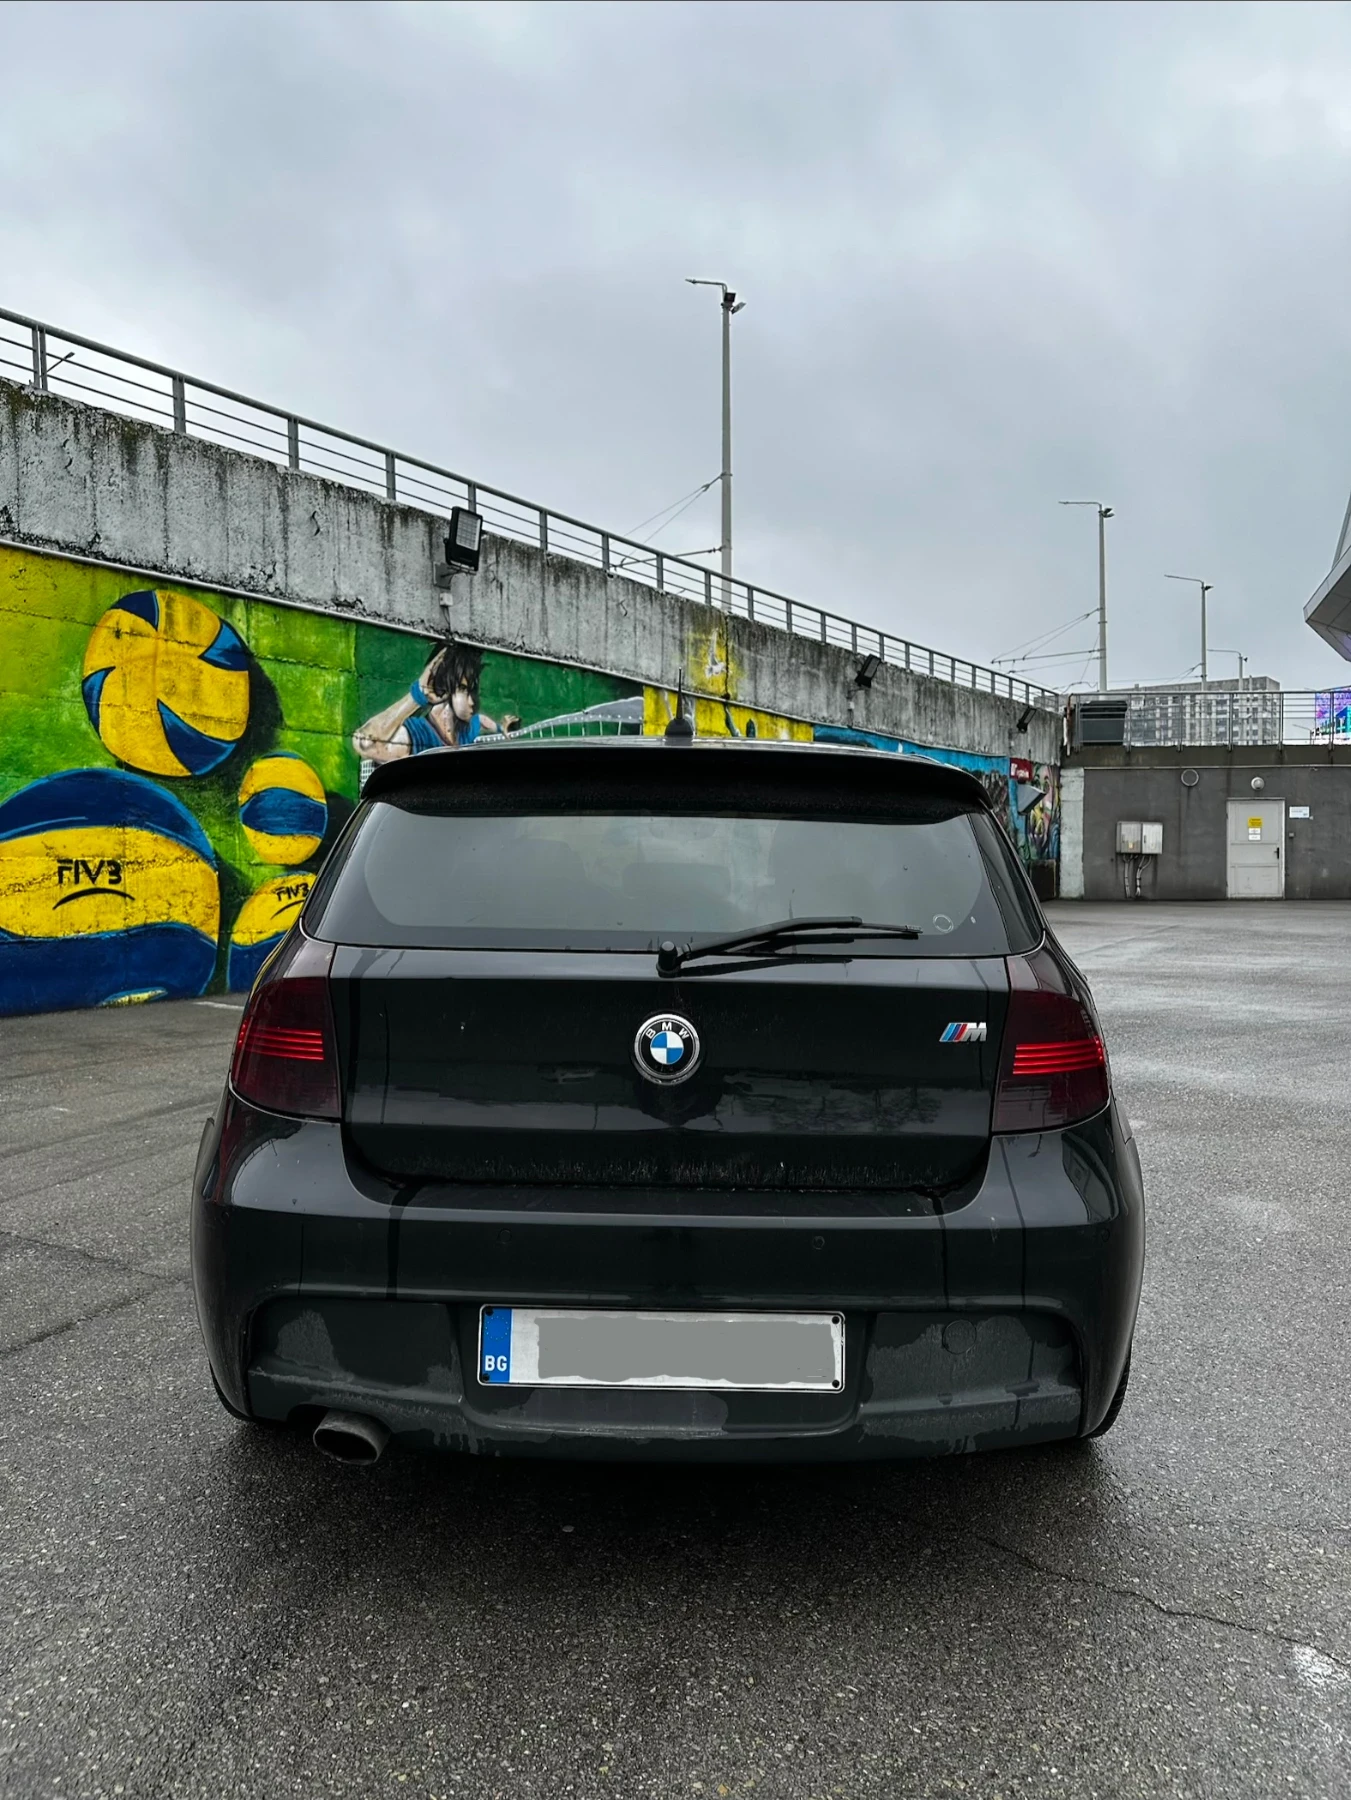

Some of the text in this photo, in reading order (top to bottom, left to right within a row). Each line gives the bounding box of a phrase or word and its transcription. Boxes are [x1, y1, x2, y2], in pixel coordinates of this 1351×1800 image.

[645, 1021, 690, 1040] BMW
[958, 1022, 987, 1042] M
[484, 1354, 508, 1372] BG
